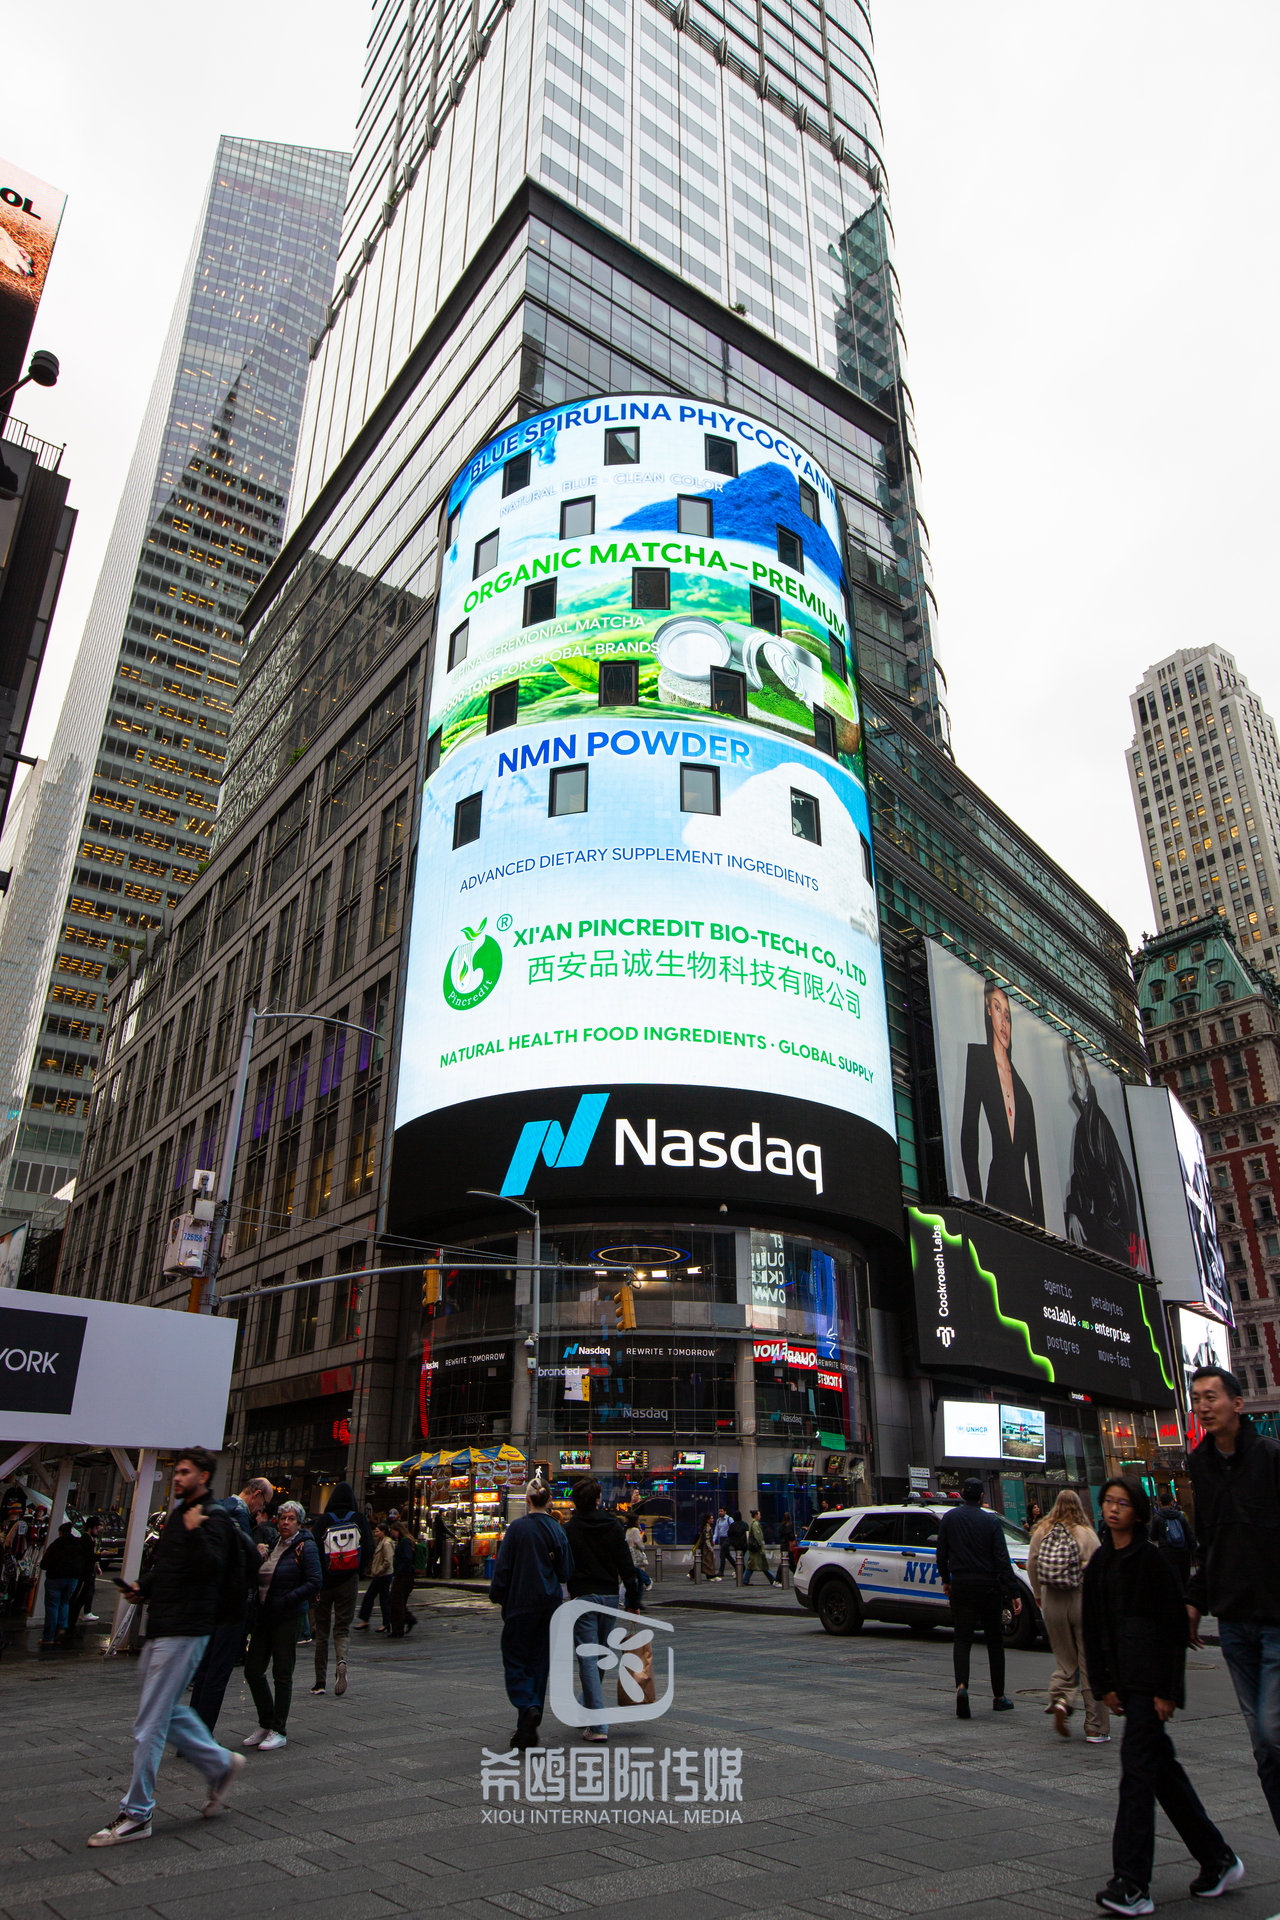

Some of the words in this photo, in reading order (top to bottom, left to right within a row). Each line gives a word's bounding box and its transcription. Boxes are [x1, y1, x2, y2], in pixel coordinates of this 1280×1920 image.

[470, 433, 519, 481] BLUE
[524, 403, 671, 448] SPIRULINA
[679, 405, 837, 506] PHYCOCYANIN
[562, 475, 598, 492] BLUE
[613, 472, 664, 485] CLEAN
[670, 474, 724, 493] COLOR
[463, 547, 581, 614] ORGANIC
[486, 625, 573, 660] CEREMONIAL
[576, 616, 645, 631] MATCHA
[468, 674, 499, 693] TONS
[501, 658, 527, 678] FOR
[530, 646, 592, 666] GLOBAL
[595, 641, 661, 654] BRANDS
[498, 734, 576, 776] NMN
[587, 730, 751, 766] POWDER
[459, 857, 536, 893] ADVANCED
[539, 848, 608, 870] DIETARY
[612, 848, 723, 866] SUPPLEMENT
[727, 854, 820, 891] INGREDIENTS
[513, 922, 572, 948] XI'AN
[578, 918, 704, 940] PINCREDIT
[710, 922, 807, 958] BIO-TECH
[845, 960, 868, 987] LTD
[448, 980, 492, 1006] Pincredit
[527, 947, 861, 1020] 西安品诚生物科技有限公司
[440, 1038, 504, 1068] NATURAL
[508, 1028, 578, 1050] HEALTH
[582, 1026, 638, 1043] FOOD
[643, 1026, 767, 1051] INGREDIENTS
[779, 1038, 836, 1067] GLOBAL
[838, 1056, 874, 1084] SUPPLY
[614, 1118, 823, 1195] Nasdaq
[932, 1224, 943, 1252] Labs
[934, 1254, 949, 1317] Cockroach
[1043, 1279, 1073, 1299] agentic
[1090, 1296, 1124, 1317] petabytes
[1043, 1306, 1077, 1327] scalable
[1094, 1322, 1131, 1344] enterprise
[445, 1356, 467, 1367] REWRITE
[469, 1352, 506, 1363] TOMORROW
[579, 1346, 611, 1357] Nasdaq
[626, 1347, 664, 1356] REWRITE
[668, 1348, 716, 1357] TOMORROW
[1046, 1335, 1080, 1355] postgres
[1097, 1349, 1131, 1369] move-fast
[818, 1358, 839, 1369] REWRITE
[623, 1407, 669, 1421] Nasdaq
[903, 1561, 953, 1586] NYP
